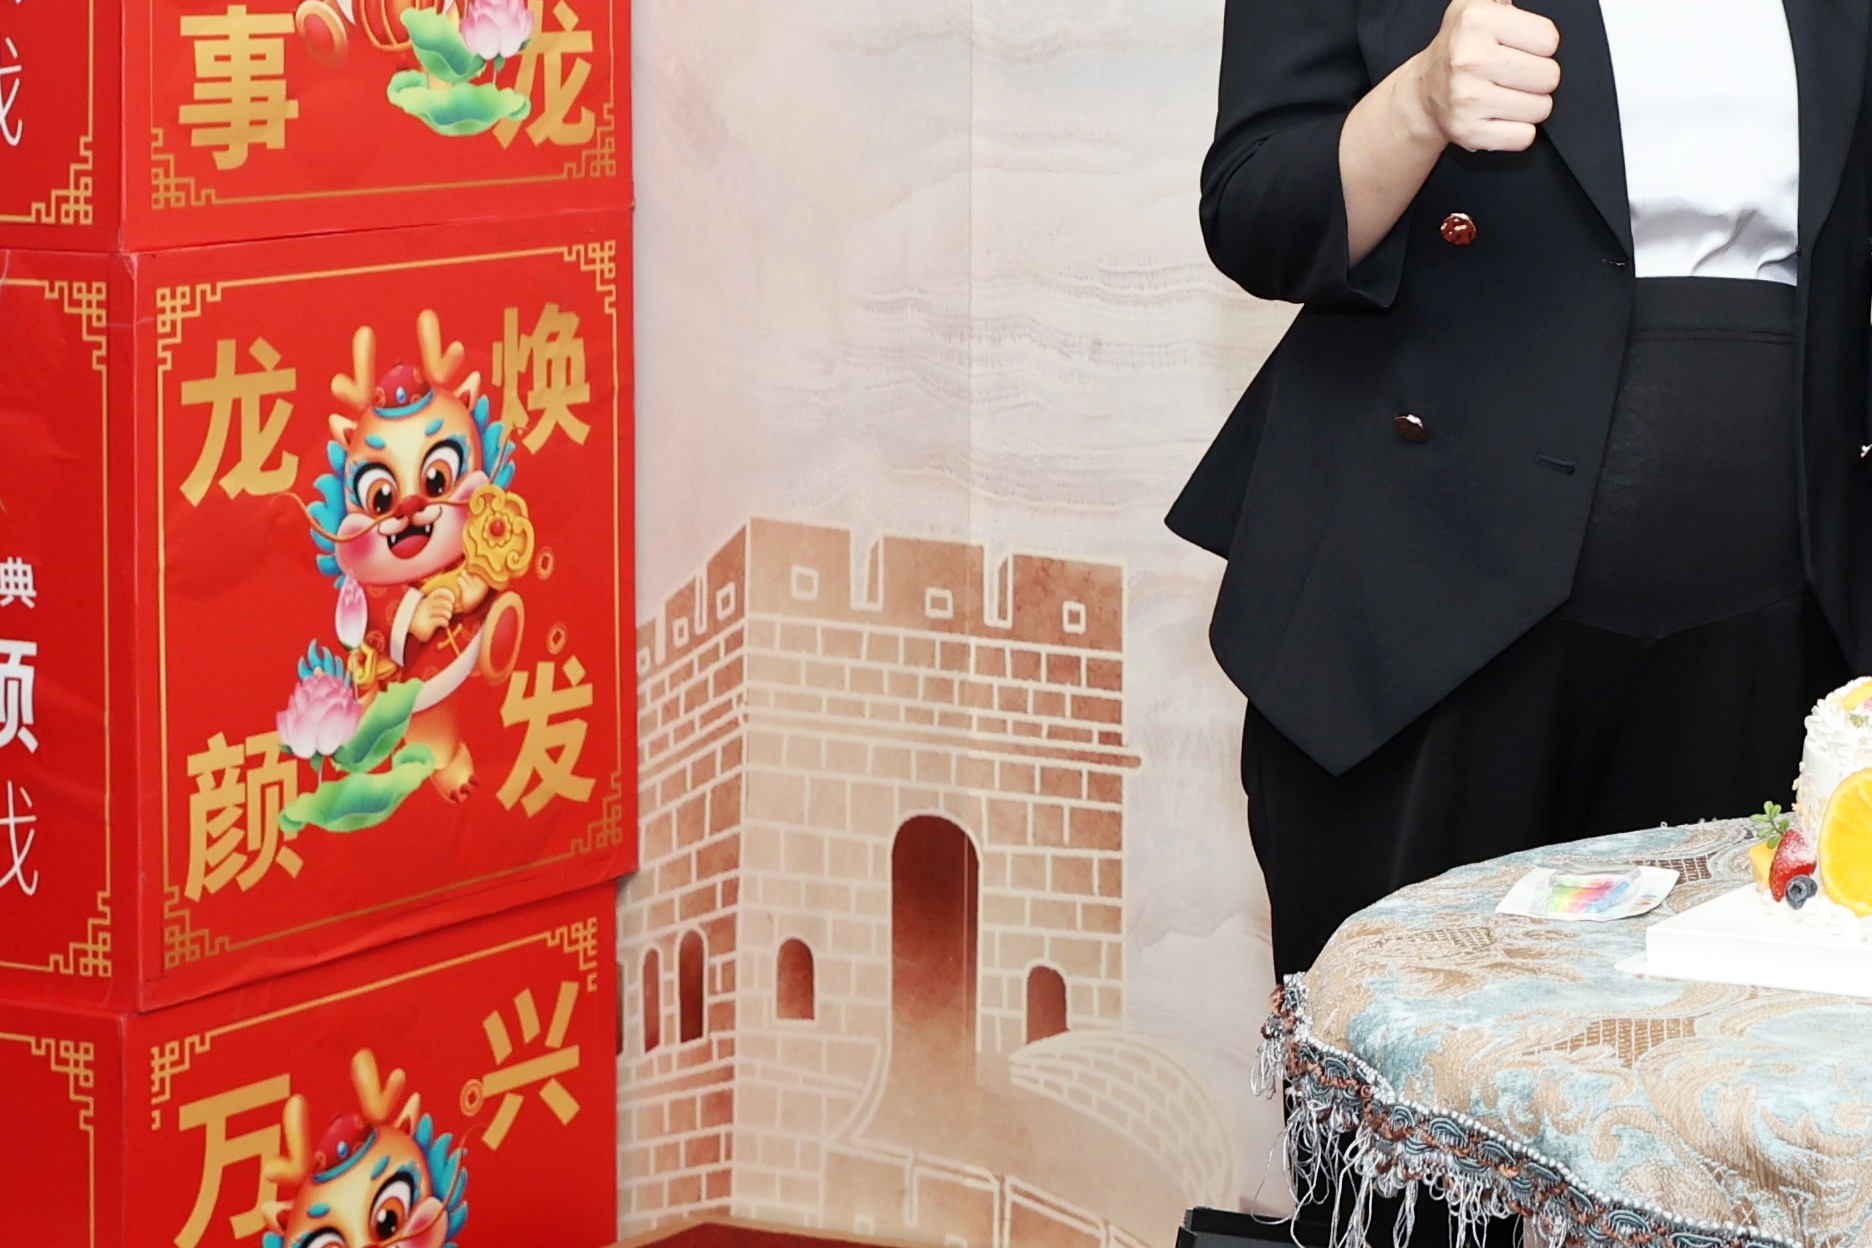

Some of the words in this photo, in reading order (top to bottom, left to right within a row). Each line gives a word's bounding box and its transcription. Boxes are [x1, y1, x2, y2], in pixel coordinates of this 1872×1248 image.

[179, 5, 299, 170] 事
[497, 0, 594, 149] 龙
[179, 338, 298, 508] 龙
[492, 302, 591, 455] 焕
[185, 731, 304, 902] 颜
[497, 657, 596, 817] 发
[174, 1073, 290, 1248] 万
[480, 981, 580, 1150] 兴
